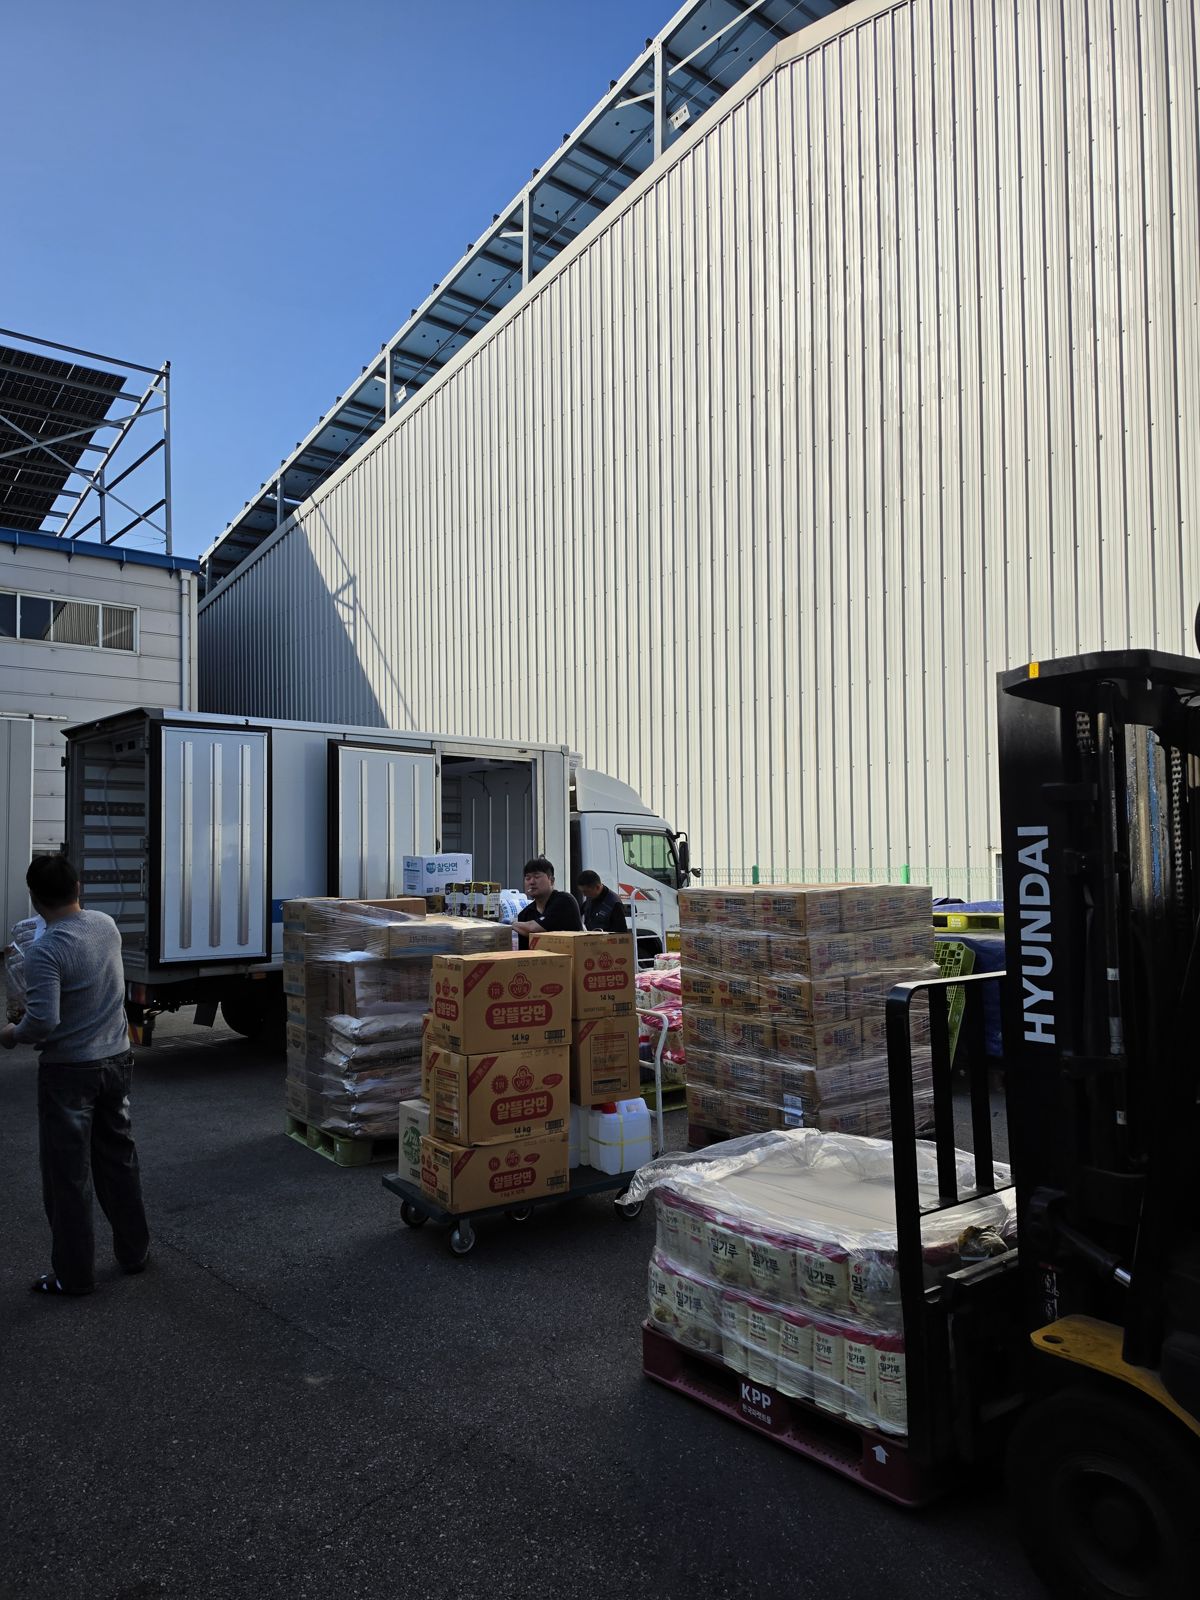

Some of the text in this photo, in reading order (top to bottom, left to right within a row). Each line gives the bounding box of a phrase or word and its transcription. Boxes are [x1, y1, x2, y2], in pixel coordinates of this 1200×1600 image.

[437, 861, 458, 873] 찰당면
[1017, 826, 1056, 1045] HYUNDAI
[587, 974, 625, 988] 알뜰당면
[607, 993, 615, 1001] kg
[492, 1004, 546, 1025] 알뜰당면
[520, 1033, 530, 1041] kg
[496, 1096, 548, 1121] 알뜰당면
[512, 1127, 521, 1135] 14
[494, 1171, 533, 1190] 알뜰당면
[711, 1236, 739, 1258] 밀가루
[752, 1250, 780, 1274] 밀가루
[652, 1279, 668, 1297] 가루
[675, 1290, 702, 1311] 밀가루
[816, 1342, 833, 1355] 밀가루
[848, 1352, 866, 1365] 밀가루
[881, 1361, 901, 1374] 밀가루
[741, 1382, 772, 1409] KPP
